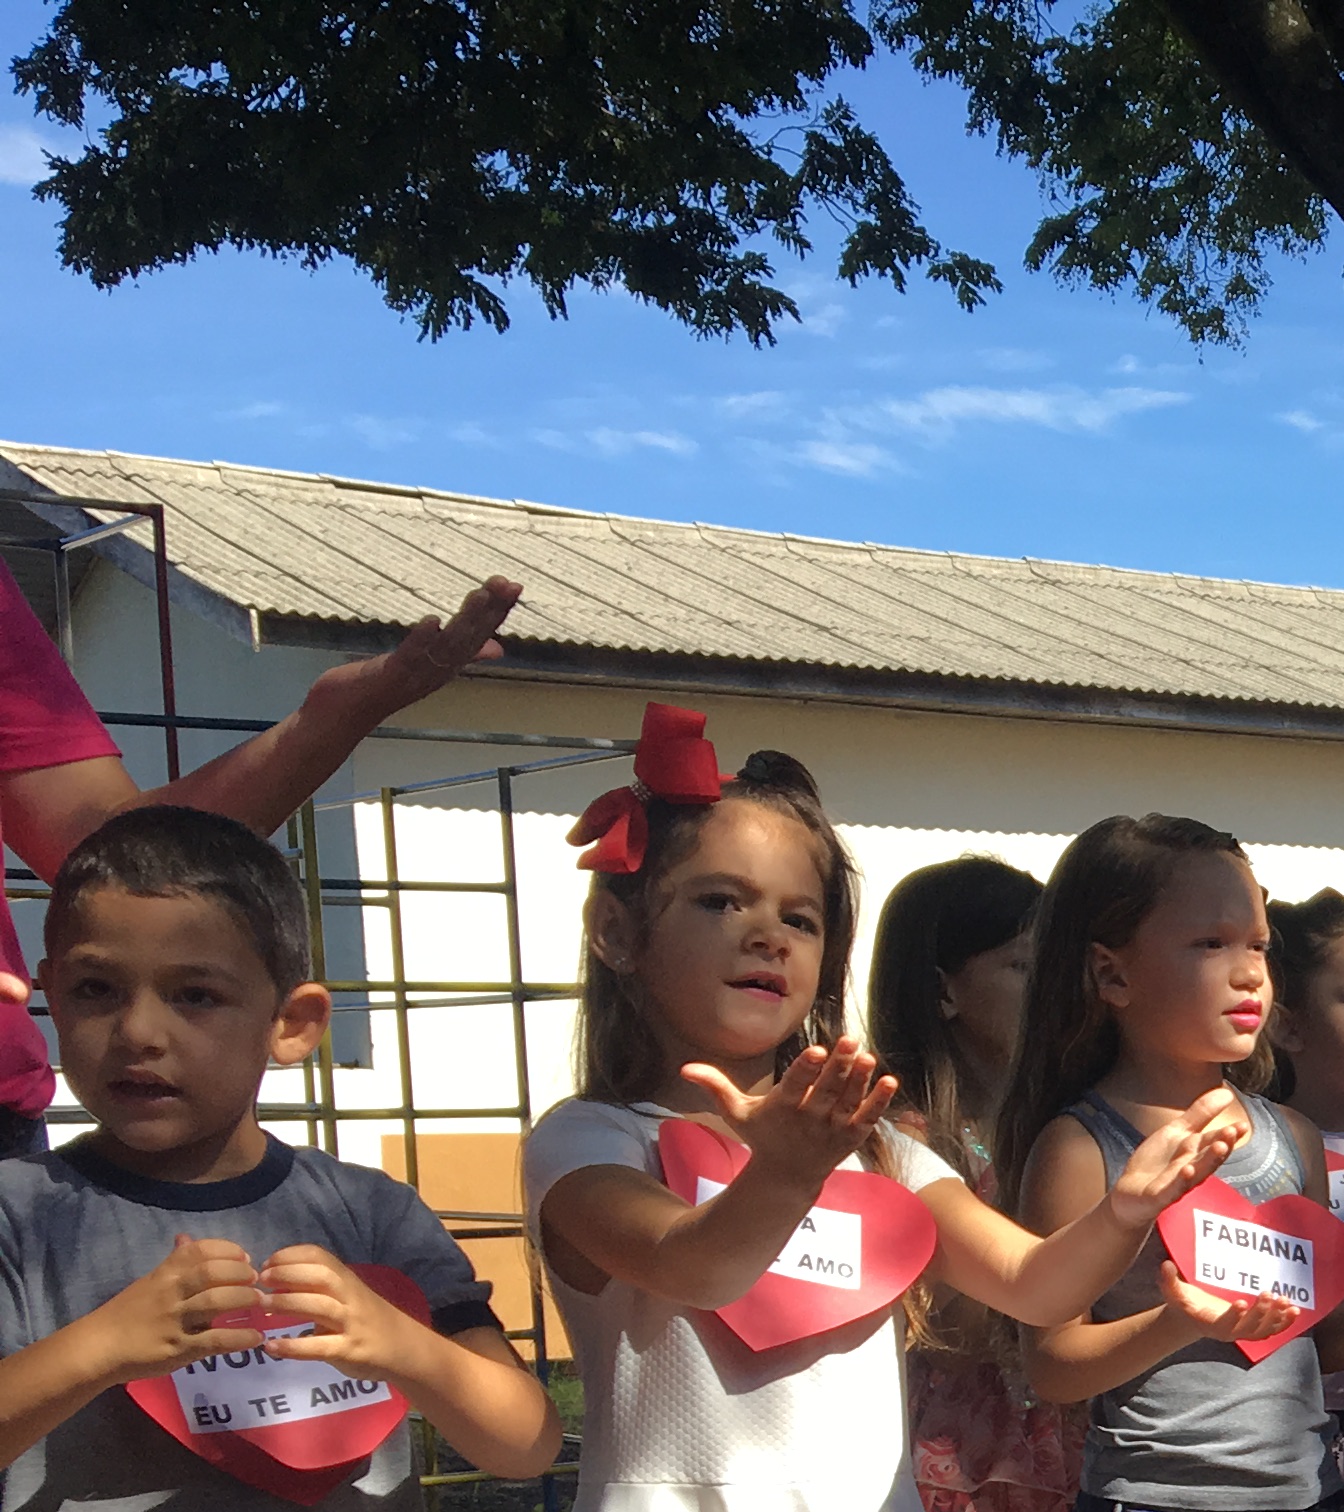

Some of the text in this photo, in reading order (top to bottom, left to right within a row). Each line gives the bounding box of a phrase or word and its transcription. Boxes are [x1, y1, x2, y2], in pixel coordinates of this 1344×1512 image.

[1202, 1219, 1309, 1265] FABIANA
[797, 1253, 854, 1279] AMO
[1201, 1262, 1310, 1303] EU TE AMO
[192, 1380, 379, 1426] EU TE AMO
